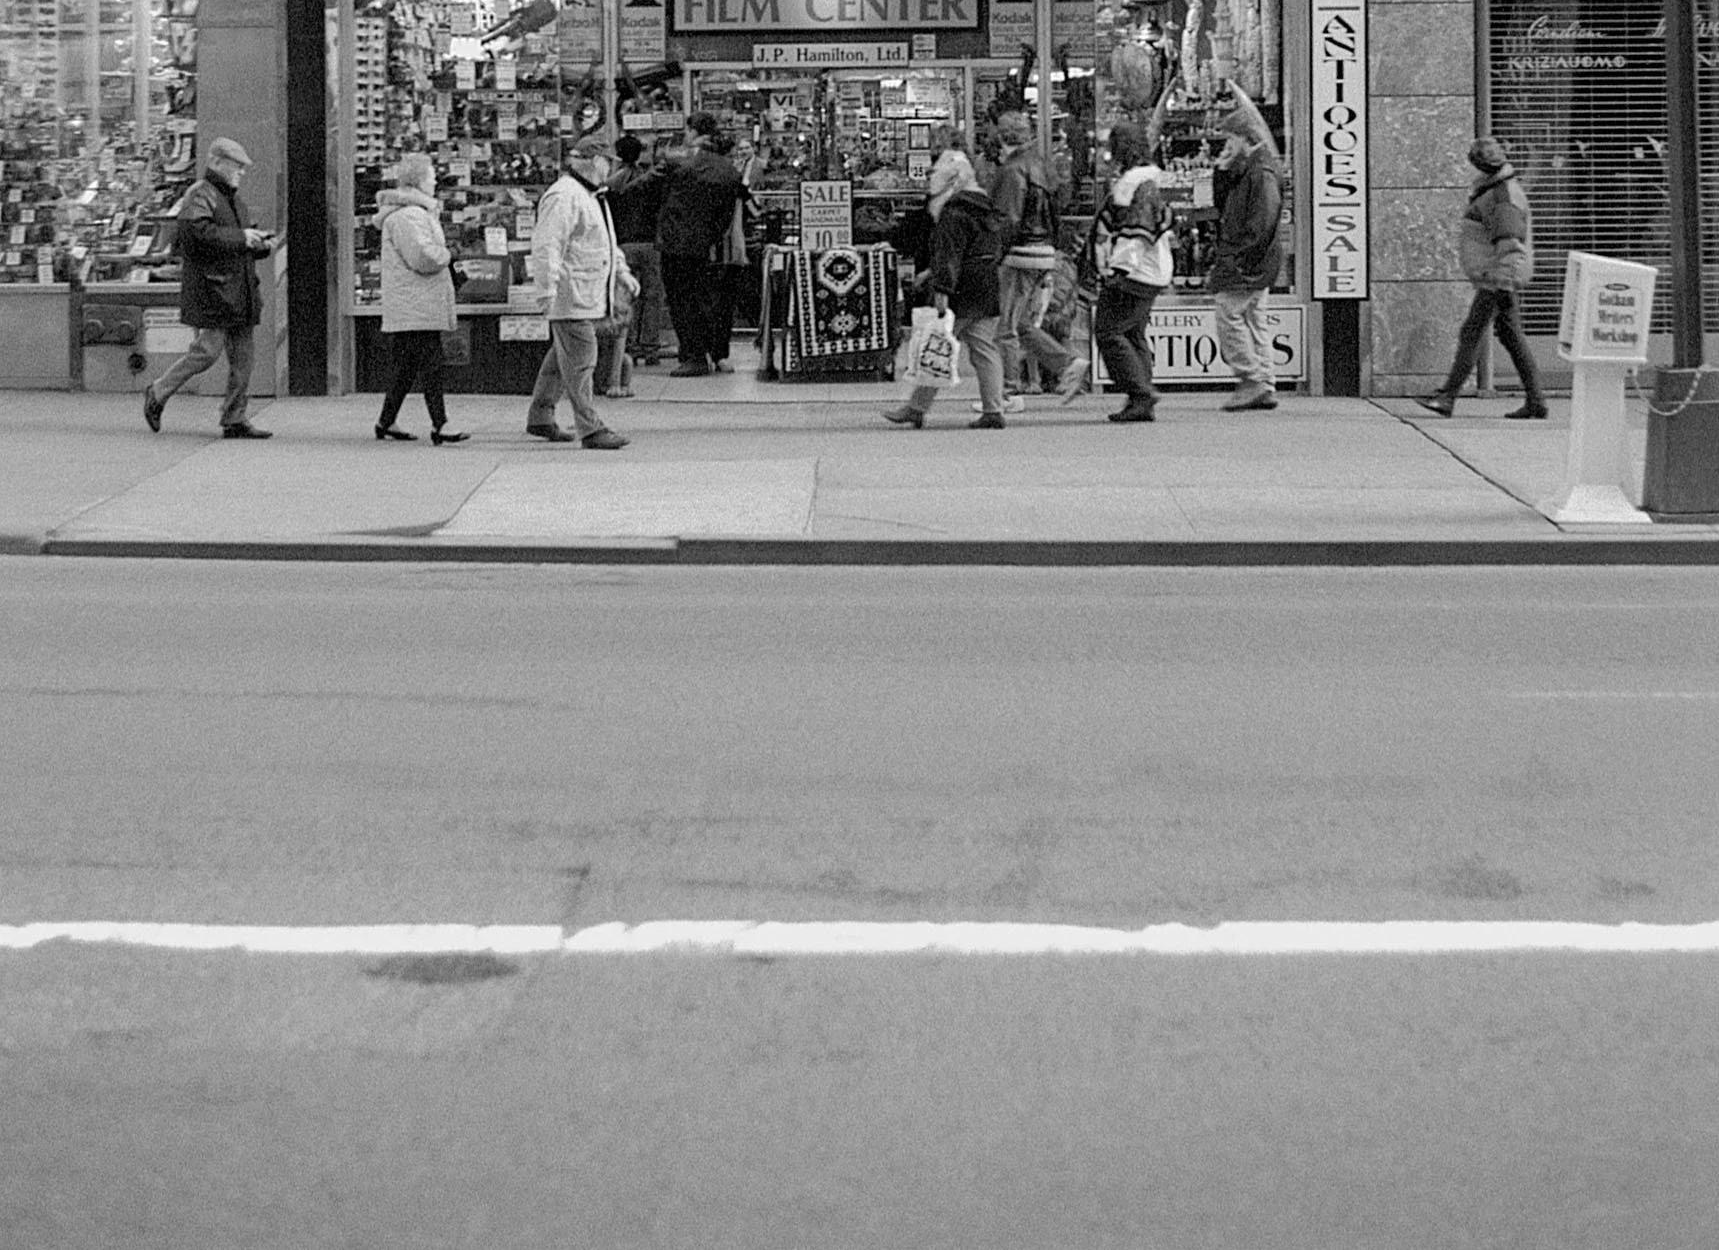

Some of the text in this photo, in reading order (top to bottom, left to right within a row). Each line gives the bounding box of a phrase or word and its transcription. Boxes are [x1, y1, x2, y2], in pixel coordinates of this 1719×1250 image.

[797, 47, 870, 62] Hamilton,
[876, 46, 906, 61] Ltd.
[1322, 13, 1358, 198] ANTIQUES
[803, 185, 849, 203] SALE
[1323, 214, 1360, 293] SALE
